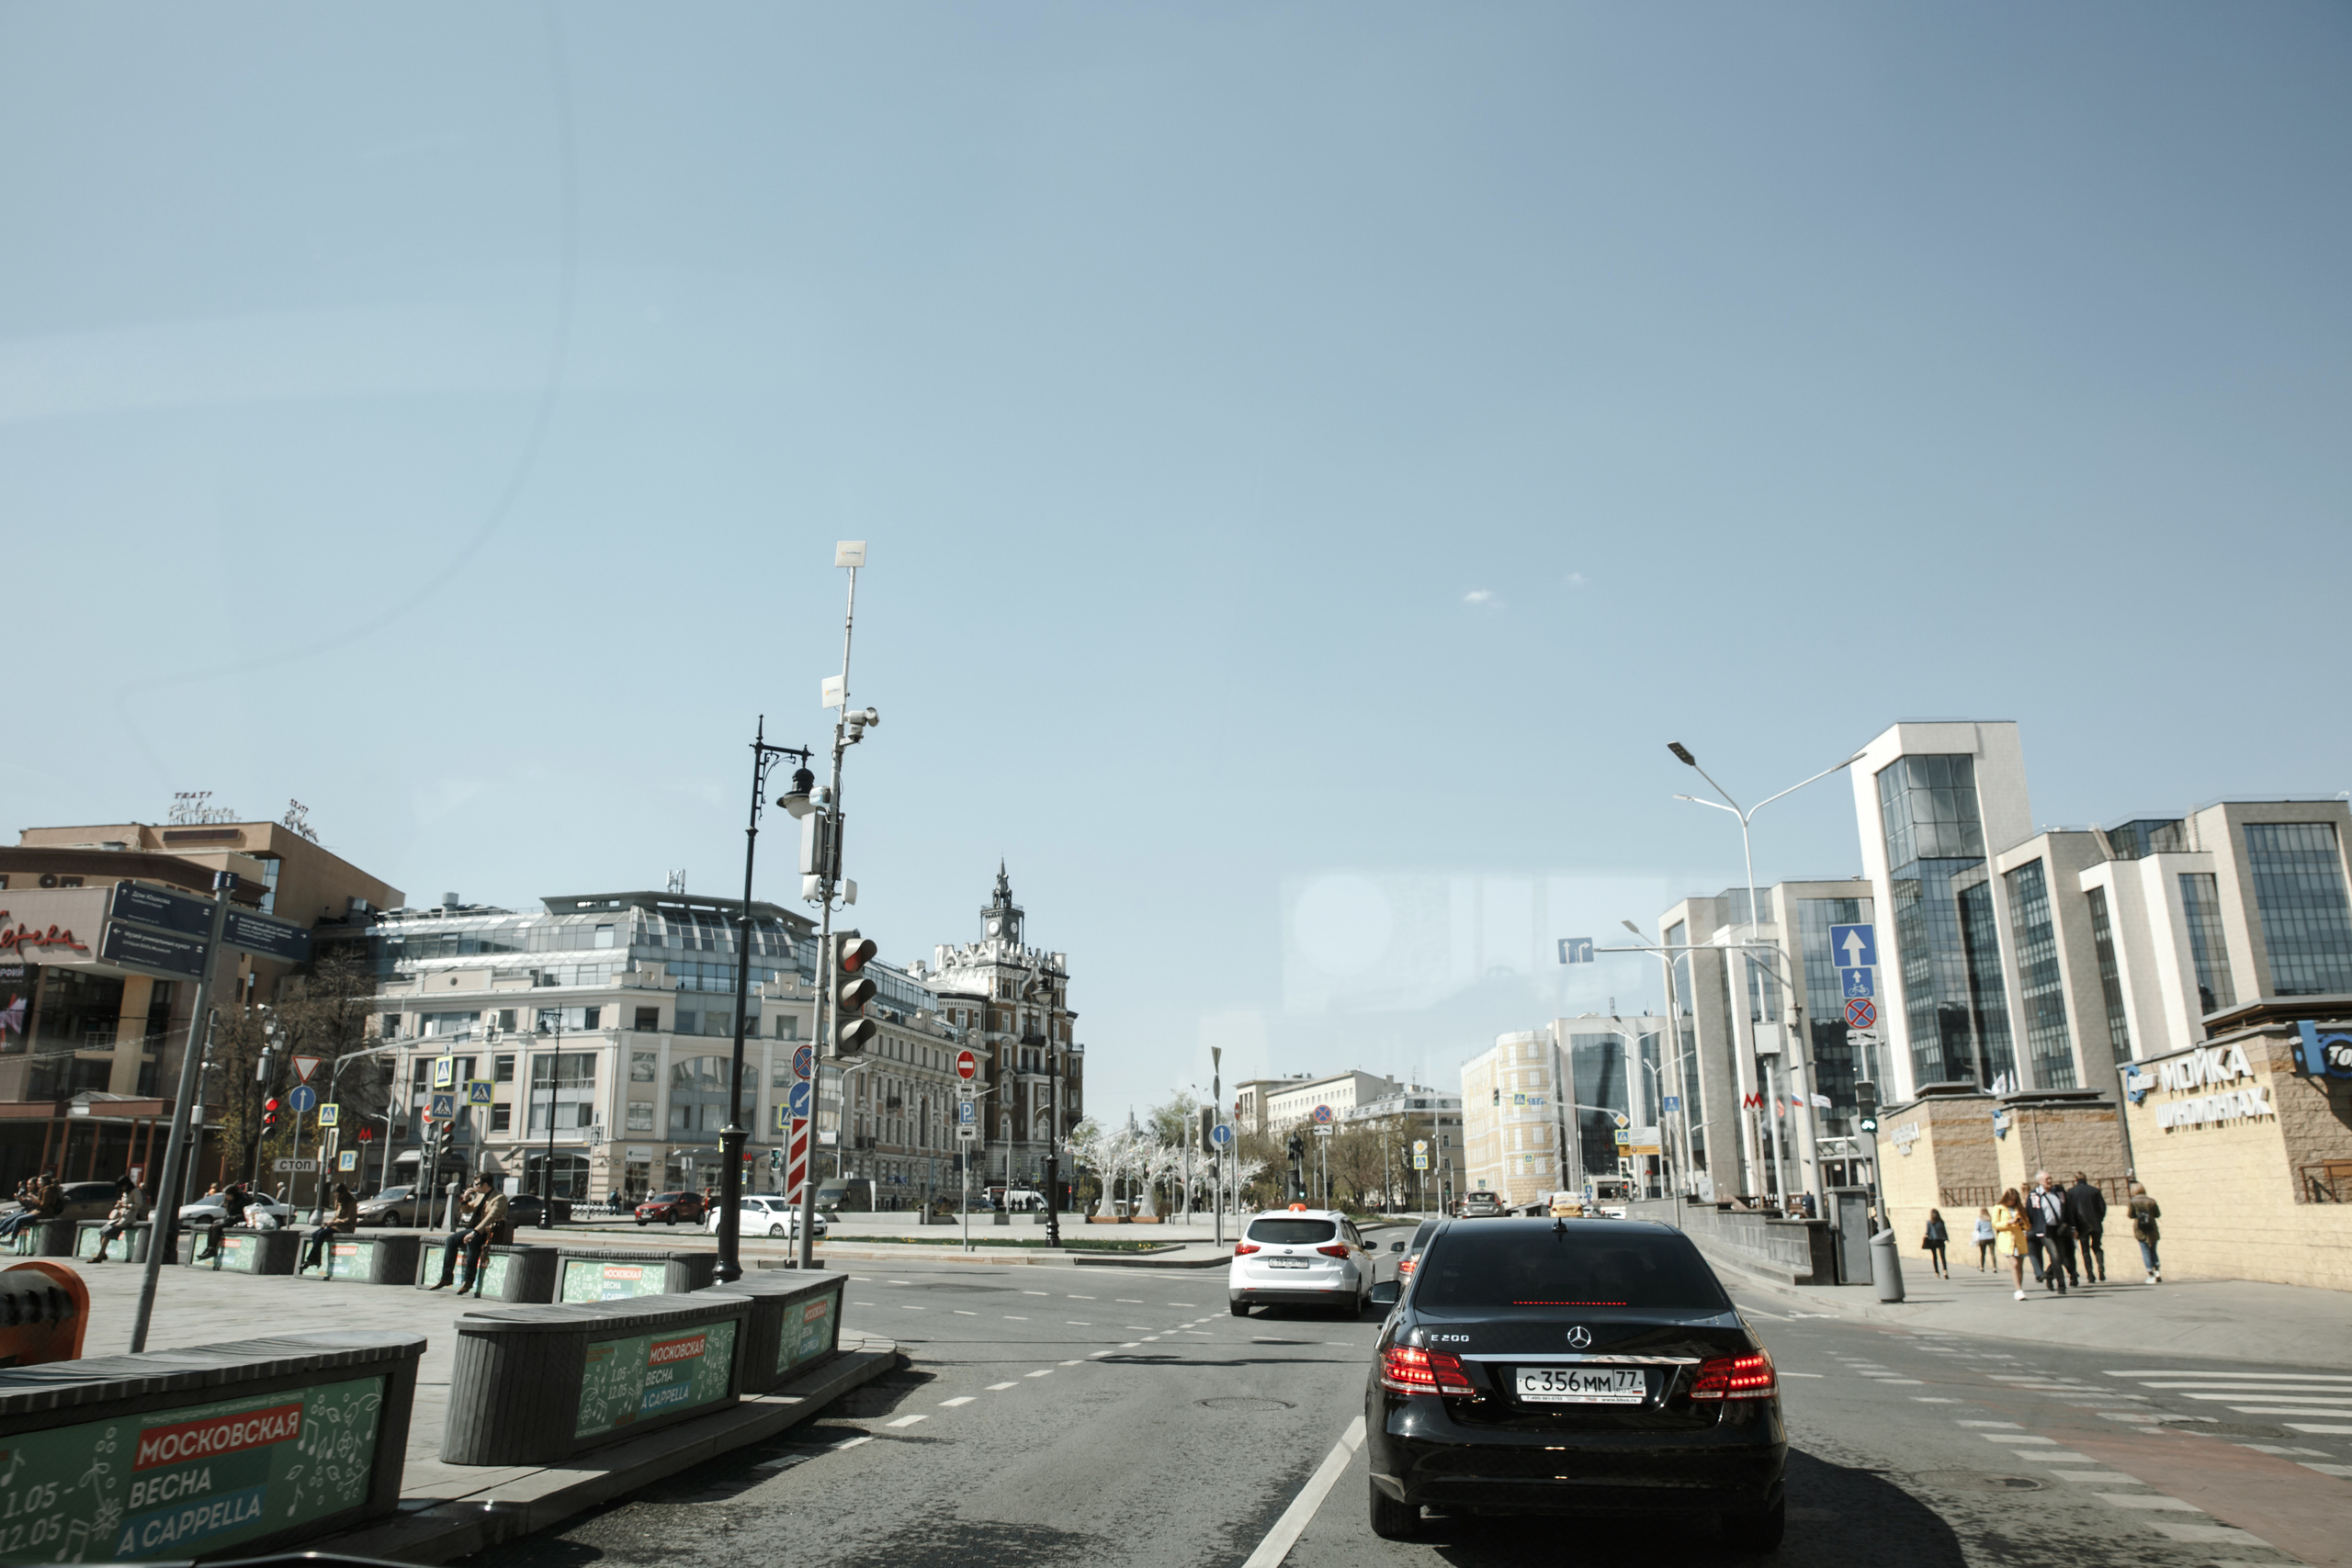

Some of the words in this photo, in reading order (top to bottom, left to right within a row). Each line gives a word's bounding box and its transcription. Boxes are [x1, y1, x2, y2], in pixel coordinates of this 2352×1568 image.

[175, 791, 213, 799] ТЕАТР
[0, 910, 88, 955] etera
[2160, 1044, 2255, 1092] МОЙКА
[2155, 1087, 2274, 1128] ШИНОМОНТАЖ
[279, 1160, 311, 1170] СТОП
[603, 1280, 621, 1290] ВЕСНА
[604, 1269, 642, 1280] МОСКОВСКАЯ
[1442, 1334, 1469, 1342] 200
[649, 1338, 705, 1363] МОСКОВСКАЯ
[611, 1367, 627, 1382] 1.05
[645, 1368, 673, 1386] ВЕСНА
[1616, 1371, 1637, 1387] 77
[607, 1383, 628, 1400] 12.05
[648, 1386, 689, 1408] CAPPELLA
[137, 1411, 300, 1466] МОСКОВСКАЯ
[128, 1467, 212, 1510] ВЕСНА
[2, 1480, 61, 1520] 1.05
[0, 1511, 65, 1554] 12.05
[117, 1528, 136, 1557] A
[142, 1493, 262, 1549] CAPPELLA
